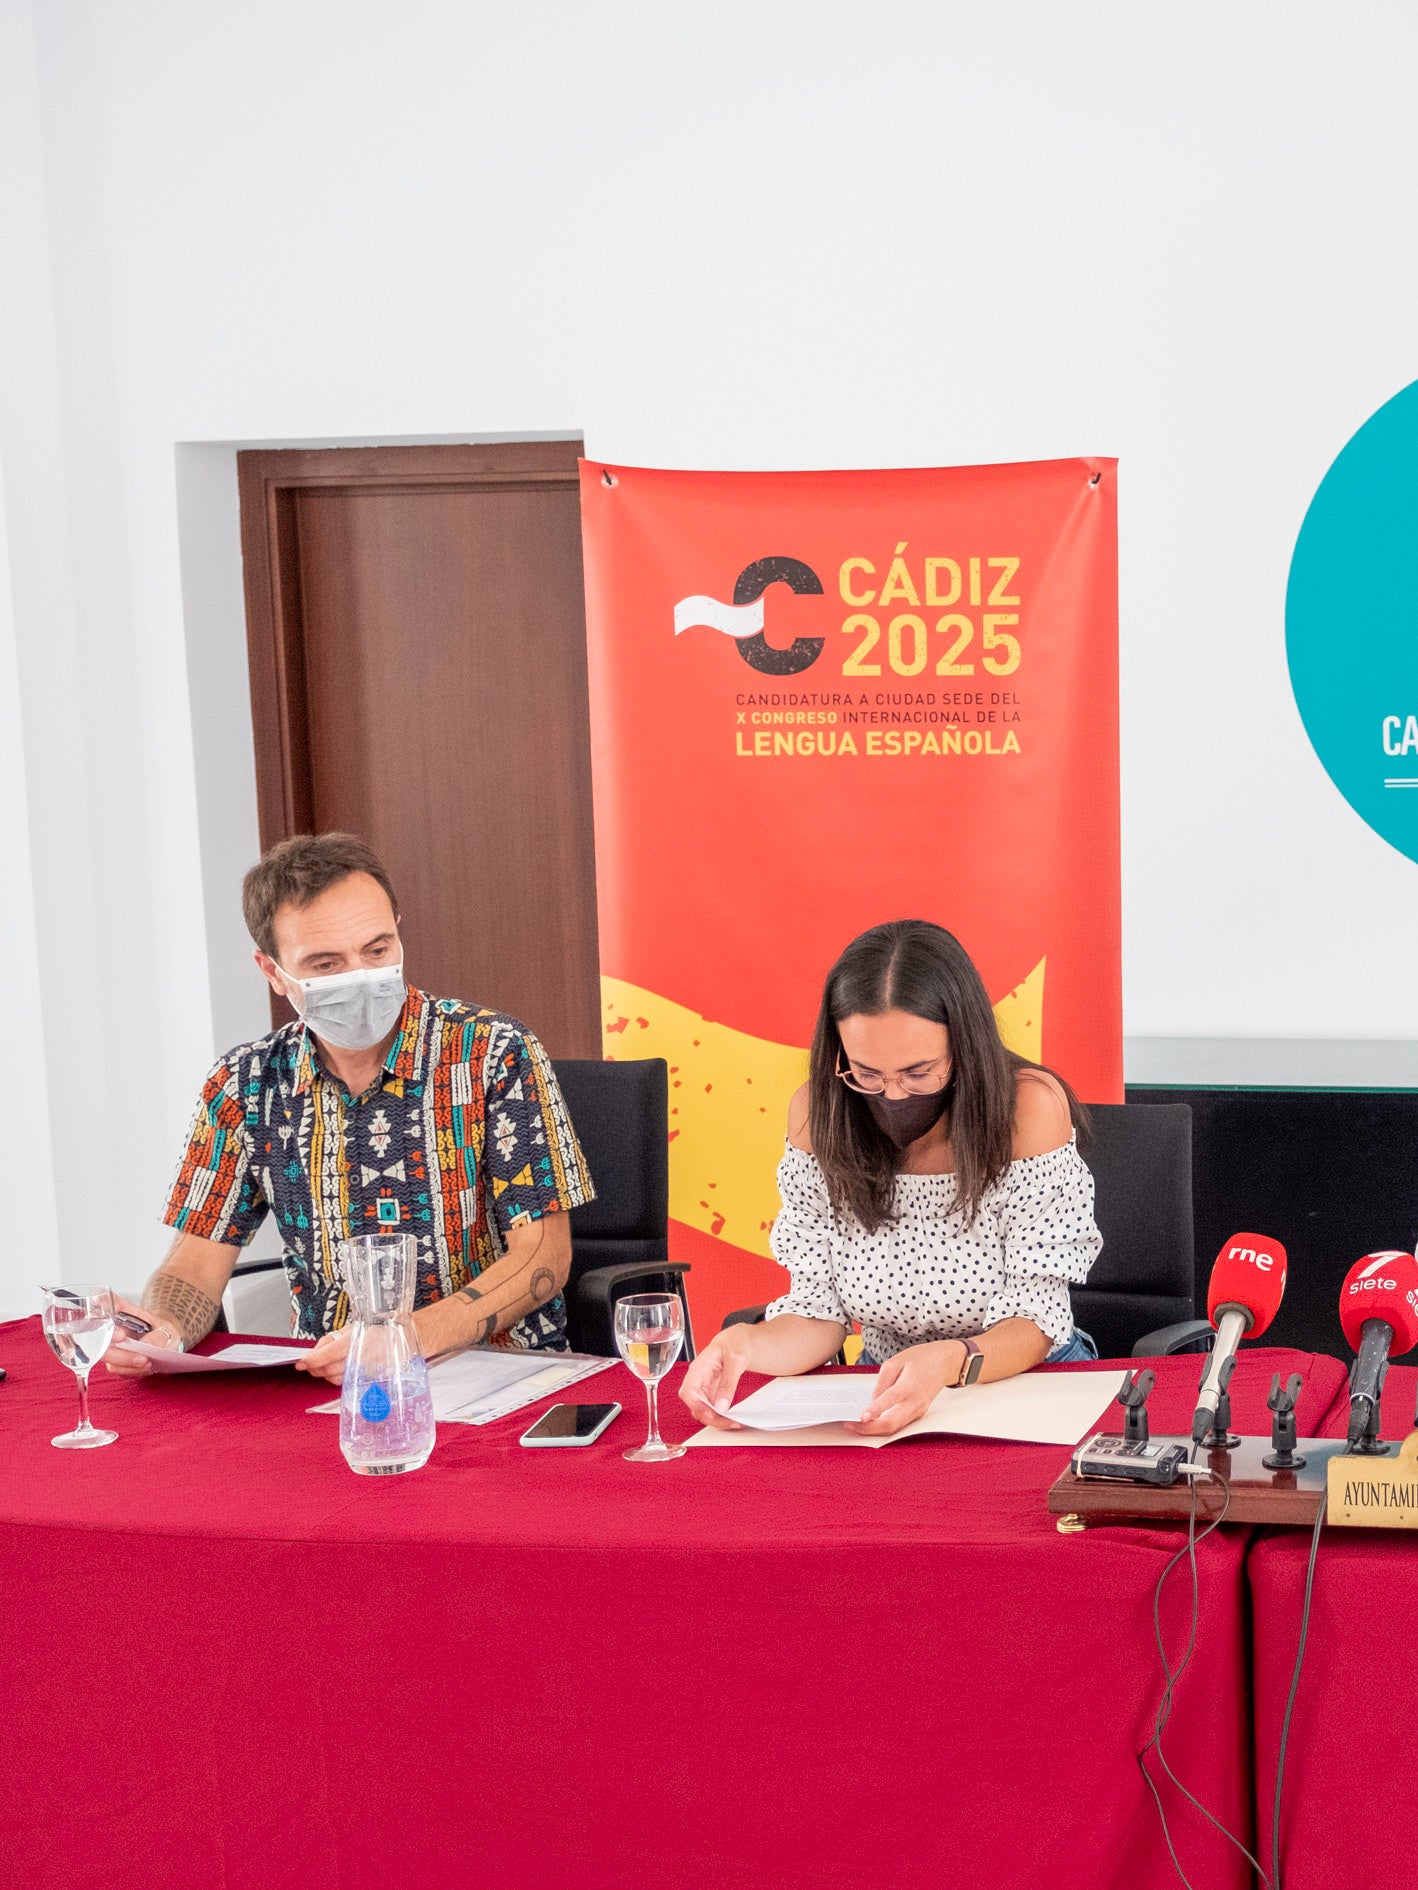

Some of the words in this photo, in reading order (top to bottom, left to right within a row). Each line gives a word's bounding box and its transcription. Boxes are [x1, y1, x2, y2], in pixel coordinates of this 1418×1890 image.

[838, 541, 1021, 607] CÁDIZ
[841, 613, 1022, 677] 2025
[736, 694, 853, 706] CANDIDATURA
[859, 694, 869, 705] A
[875, 693, 936, 705] CIUDAD
[942, 693, 983, 705] SEDE
[991, 693, 1021, 705] DEL
[736, 711, 746, 725] X
[751, 711, 838, 725] CONGRESO
[842, 711, 970, 723] INTERNACIONAL
[977, 711, 996, 723] DE
[1002, 711, 1021, 723] LA
[735, 731, 858, 757] LENGUA
[865, 724, 1021, 756] ESPAÑOLA
[1228, 1247, 1274, 1272] rne
